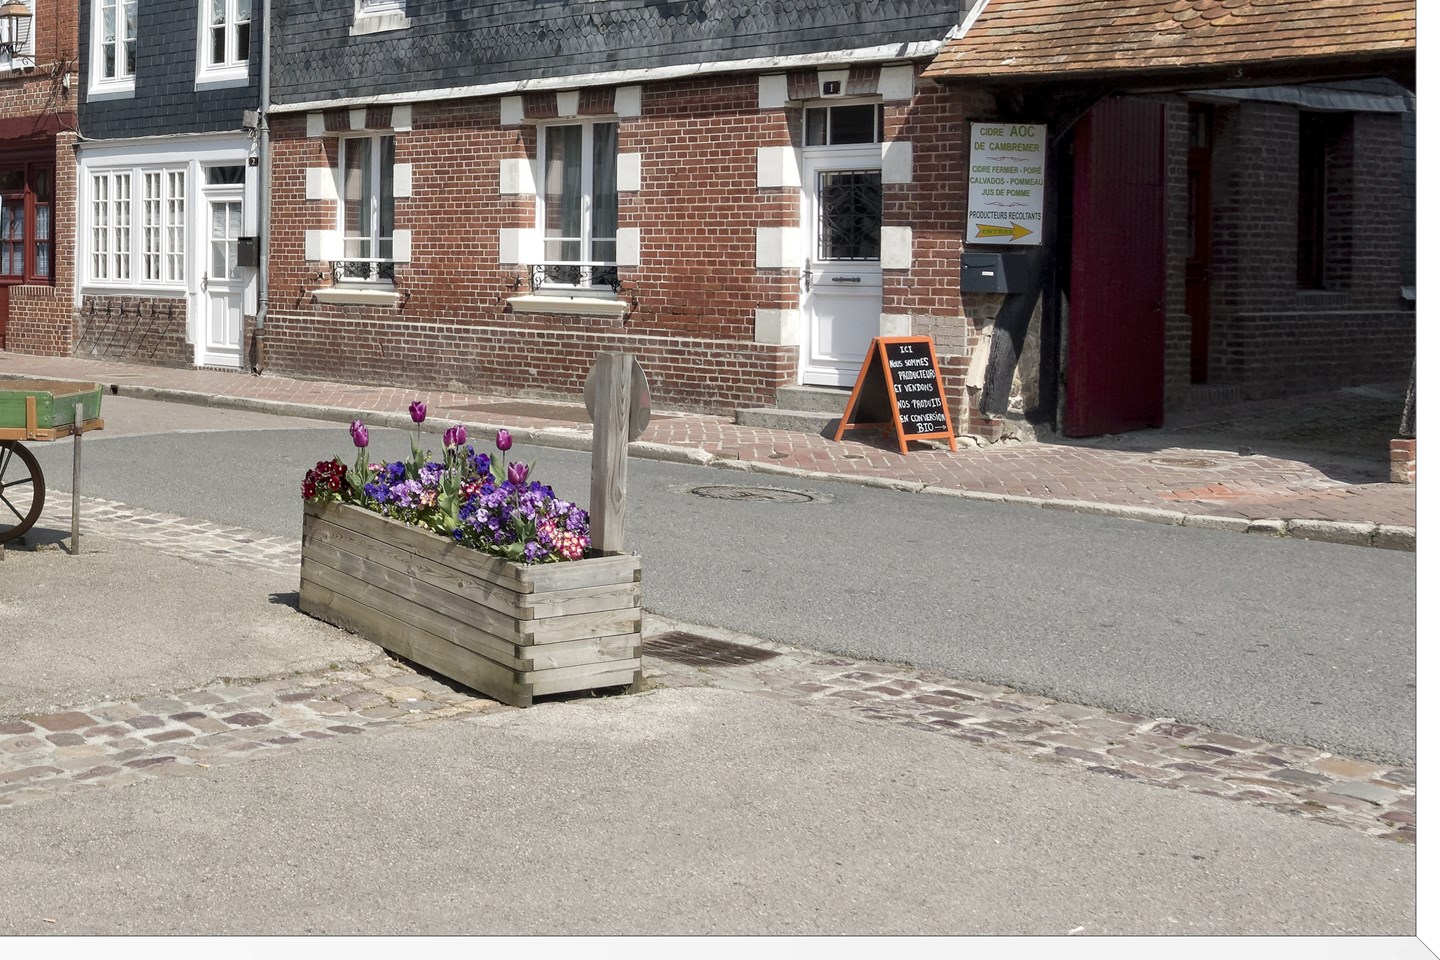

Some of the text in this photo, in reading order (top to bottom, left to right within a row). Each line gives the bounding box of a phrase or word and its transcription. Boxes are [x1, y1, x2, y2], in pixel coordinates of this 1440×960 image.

[980, 125, 1035, 137] CIDRE AOC
[975, 142, 1039, 152] DE CAMBREMER
[972, 165, 991, 173] CIDRE
[992, 166, 1019, 174] FERMIER
[970, 177, 1005, 185] CALVADOS
[1010, 178, 1044, 186] POMMEAU
[1006, 189, 1031, 197] POMME
[969, 211, 1008, 220] PRODUCTEURS
[899, 346, 913, 354] ICI
[905, 357, 929, 366] SOMMES
[893, 383, 934, 393] ET VENDONS
[897, 397, 942, 409] NOS PRODUITS
[900, 414, 909, 423] EN
[916, 422, 934, 433] BIO
